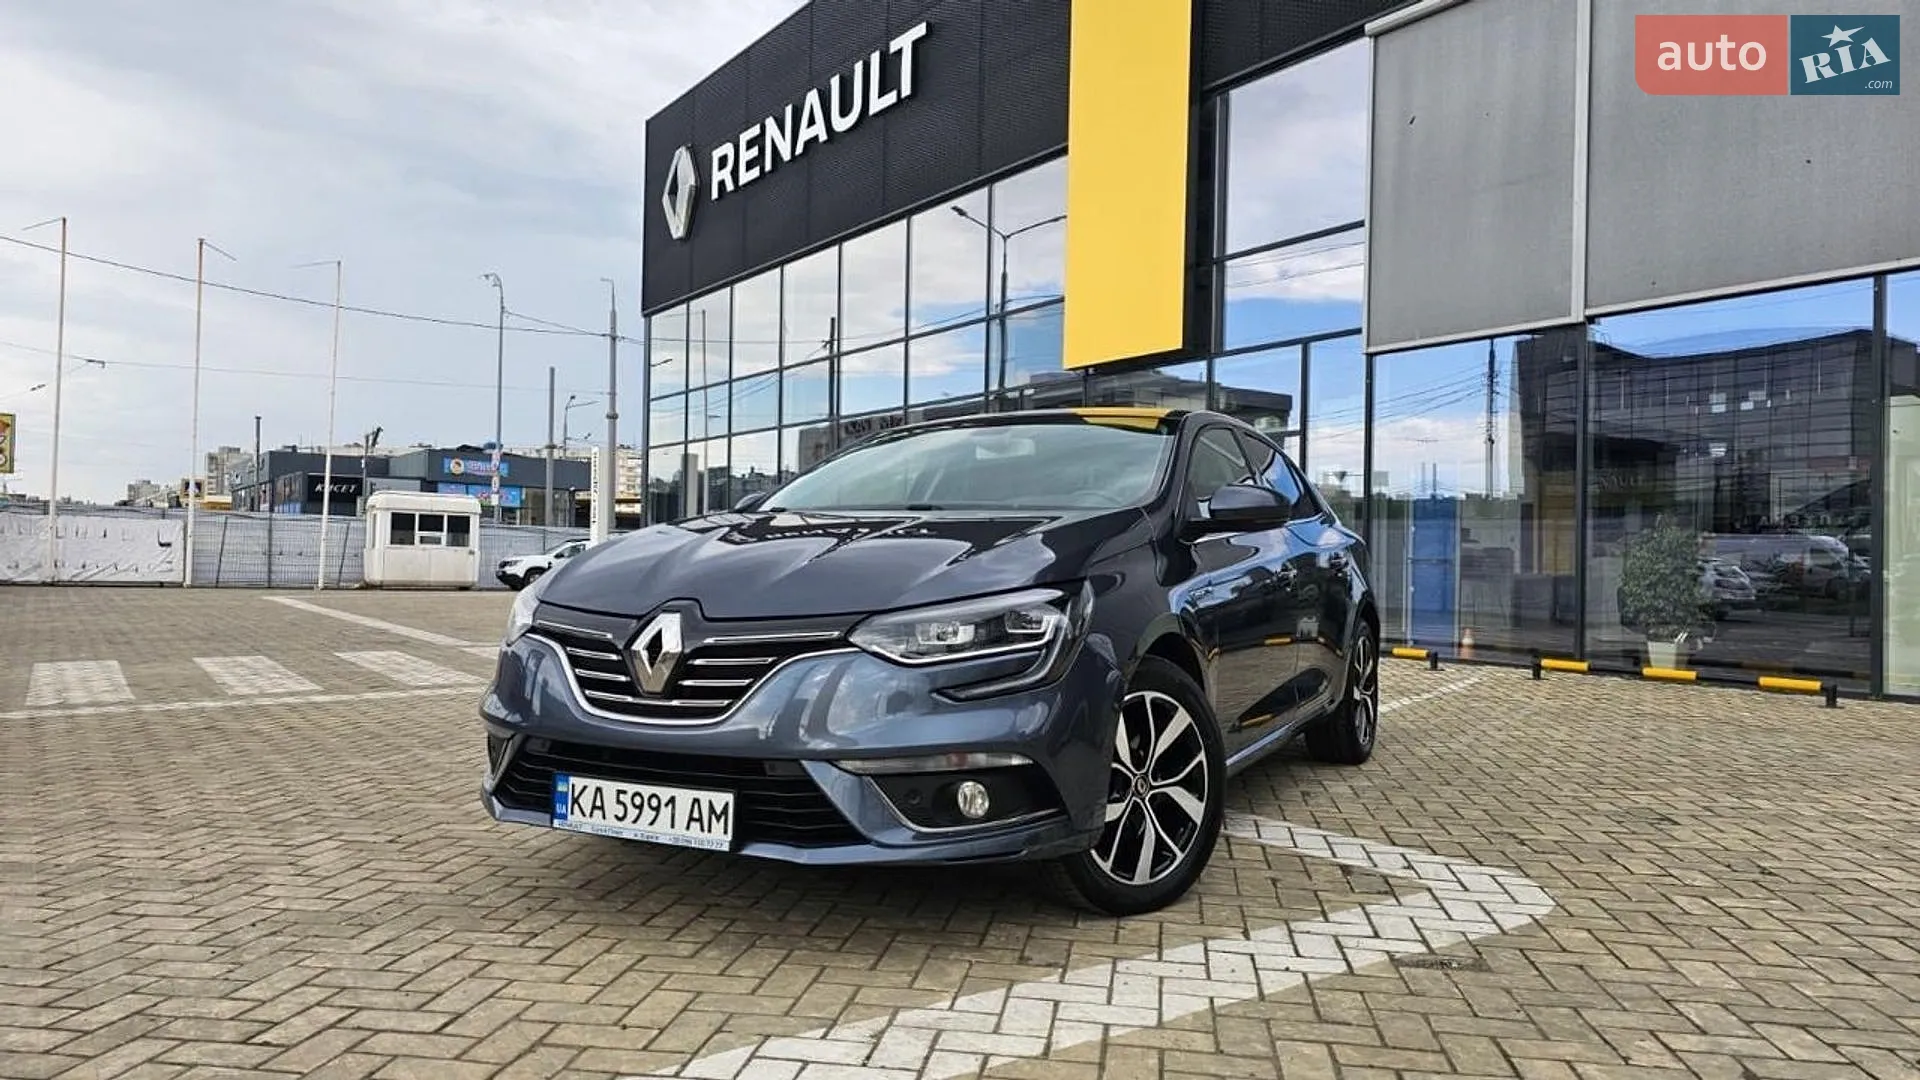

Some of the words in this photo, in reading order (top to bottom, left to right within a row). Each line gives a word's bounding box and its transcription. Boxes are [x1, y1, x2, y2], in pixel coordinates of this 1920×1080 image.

[711, 21, 928, 201] RENAULT
[571, 783, 606, 820] KA
[614, 789, 677, 829] 5991
[685, 797, 729, 835] AM
